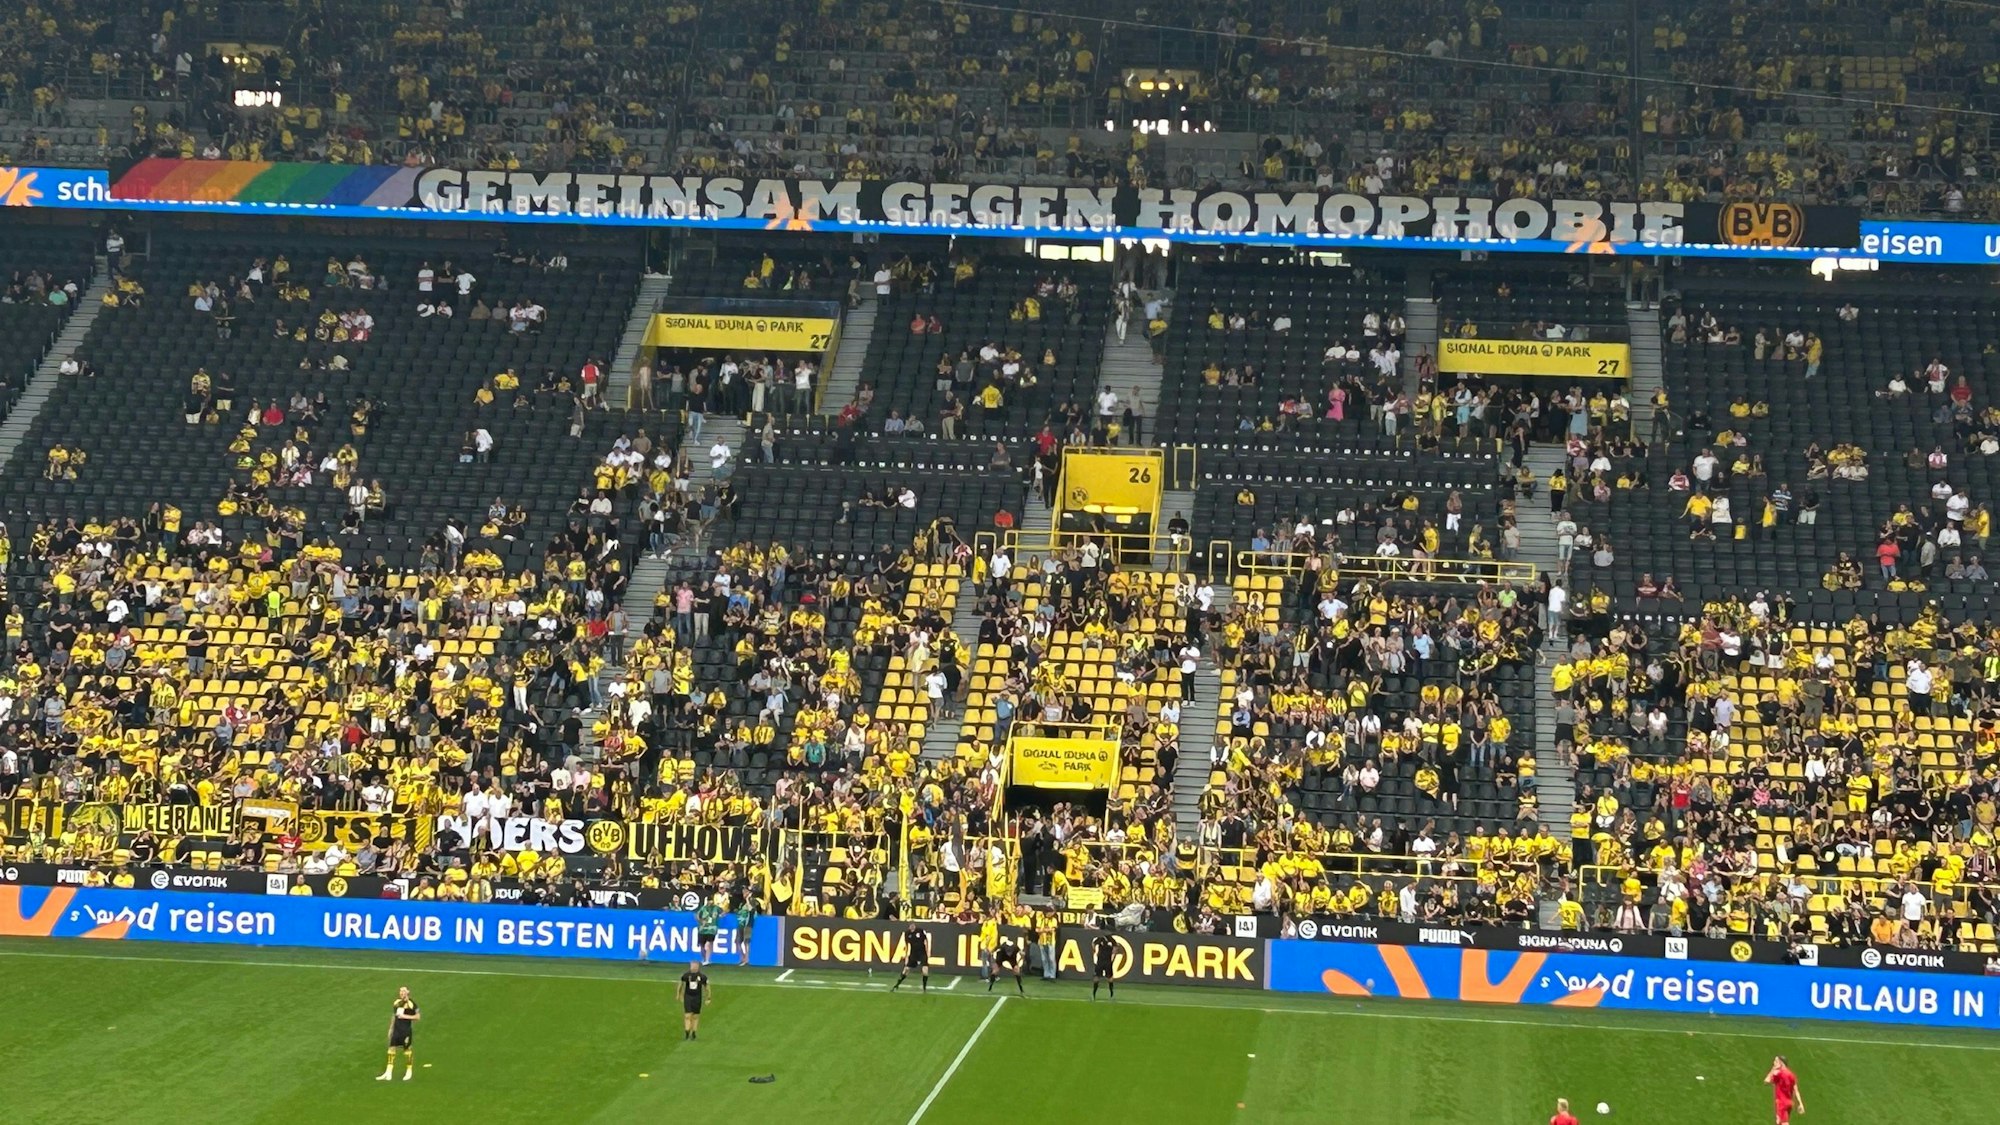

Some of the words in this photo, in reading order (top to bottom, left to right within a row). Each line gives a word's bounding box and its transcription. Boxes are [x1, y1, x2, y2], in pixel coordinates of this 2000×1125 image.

[418, 168, 862, 220] GEMEINSAM
[881, 181, 1118, 227] GEGEN
[1136, 188, 1685, 242] HOMOPHOBIE
[1733, 203, 1792, 237] BVB
[1861, 227, 1942, 256] eisen
[665, 317, 711, 330] SIGNAL
[715, 319, 753, 332] IDUNA
[771, 321, 803, 332] PARK
[810, 334, 832, 350] 27
[1447, 342, 1495, 355] SIGNAL
[1498, 344, 1537, 356] IDUNA
[1556, 346, 1591, 357] PARK
[1597, 360, 1620, 375] 27
[1129, 467, 1151, 484] 26
[126, 804, 232, 834] MEERANE
[593, 822, 620, 843] BVB
[169, 902, 275, 935] reisen
[323, 912, 442, 941] URLAUB
[455, 918, 484, 943] IN
[498, 919, 614, 948] BESTEN
[1419, 928, 1460, 944] PUMA
[1143, 942, 1255, 981] PARK
[1646, 969, 1759, 1006] reisen
[1811, 981, 1938, 1014] URLAUB
[1953, 989, 1984, 1017] IN
